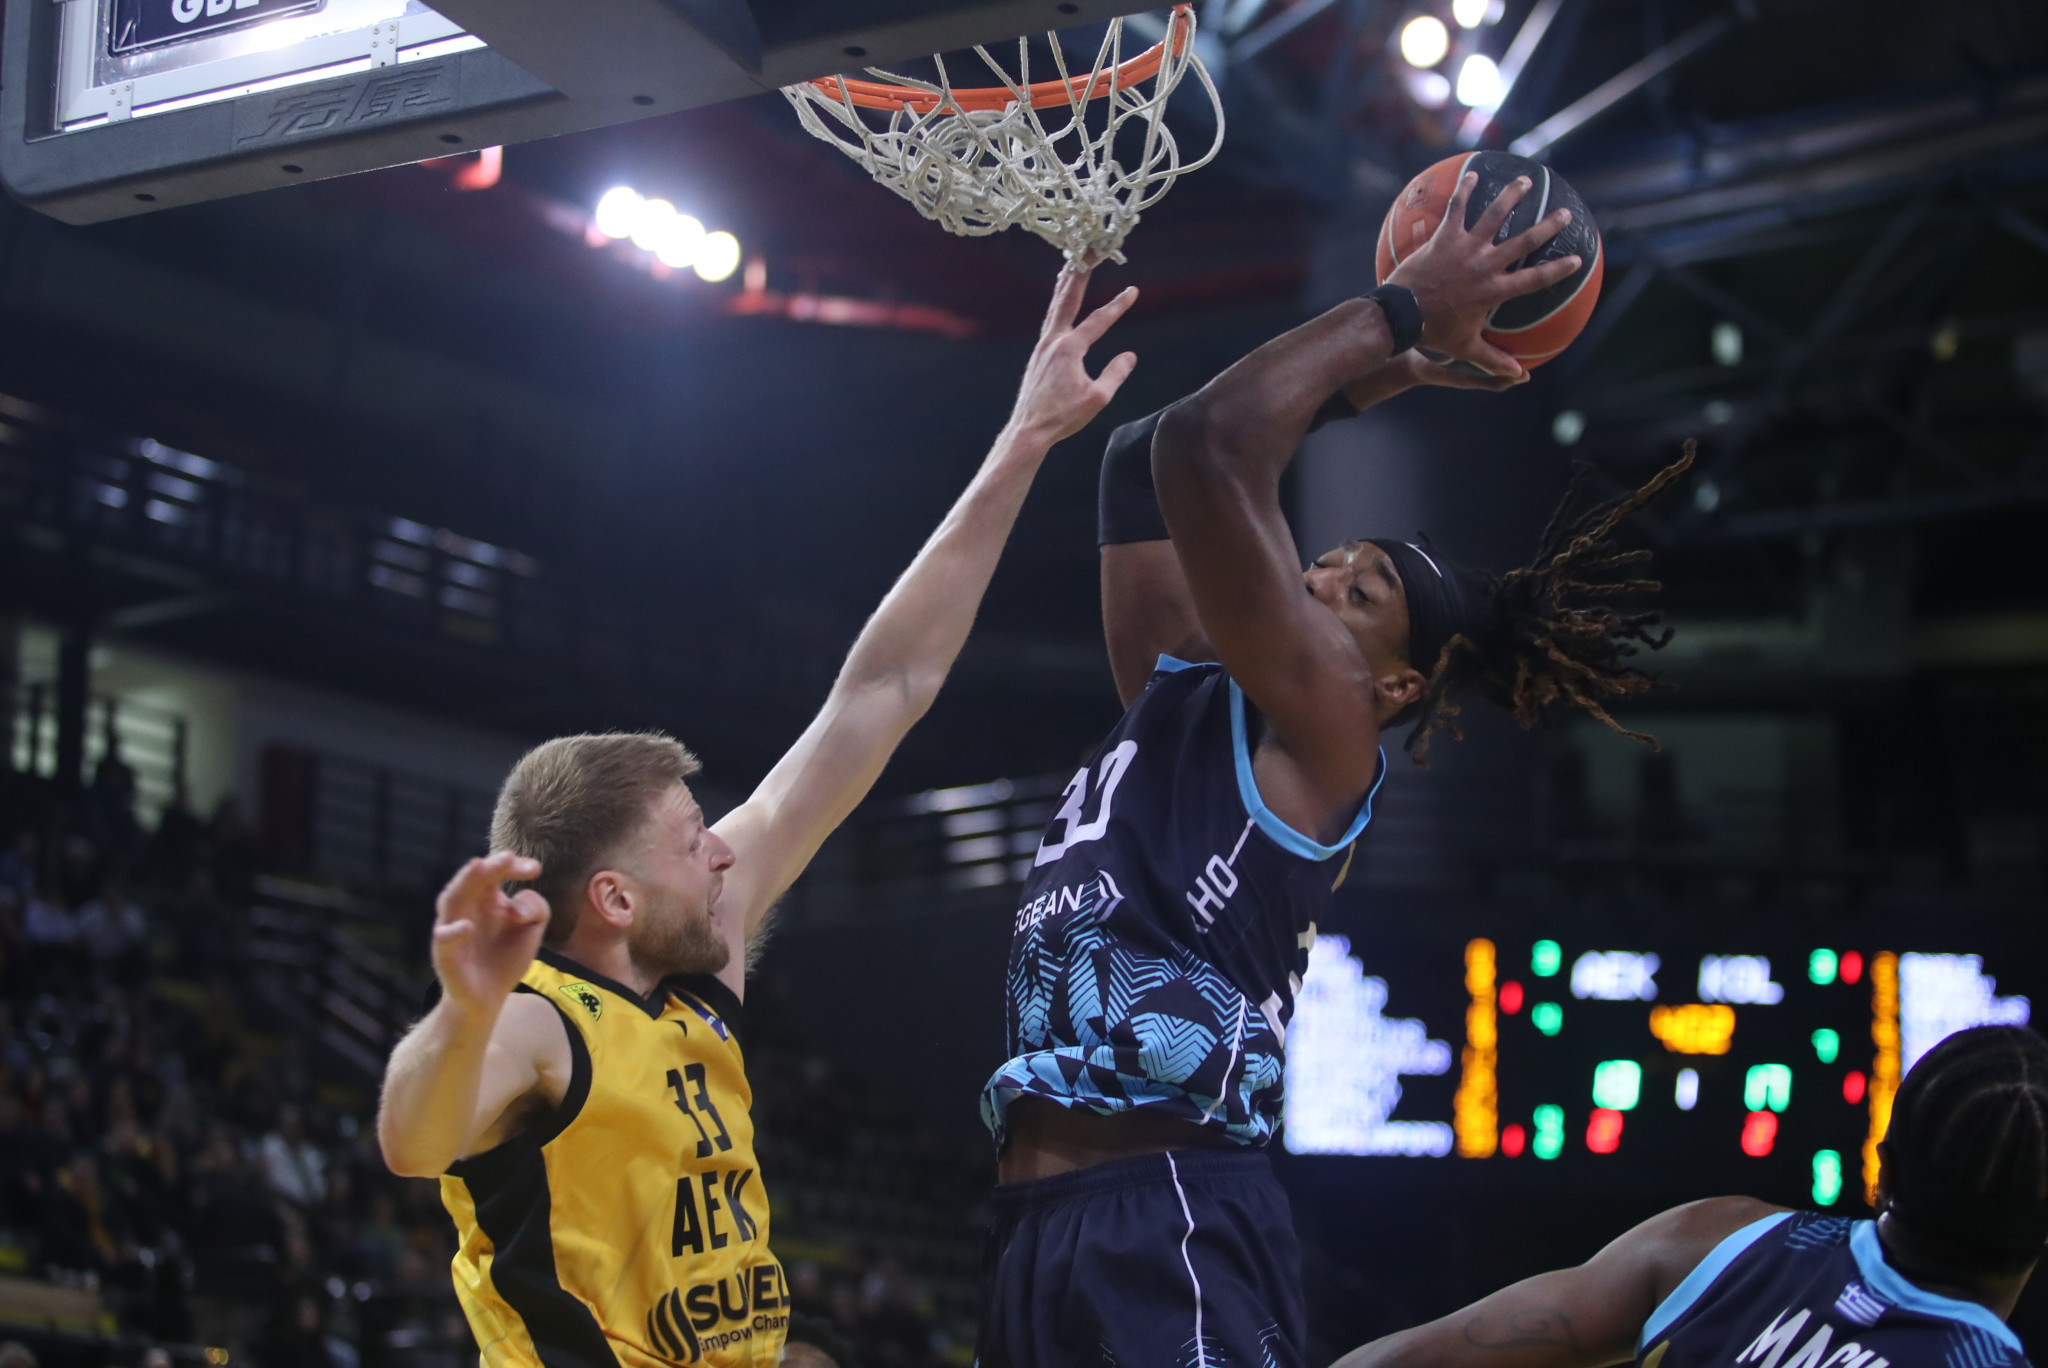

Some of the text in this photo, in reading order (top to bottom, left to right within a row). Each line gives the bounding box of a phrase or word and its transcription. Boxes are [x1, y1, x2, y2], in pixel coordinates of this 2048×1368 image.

[172, 0, 260, 24] GB
[666, 1062, 733, 1159] 33
[672, 1169, 757, 1258] AEK
